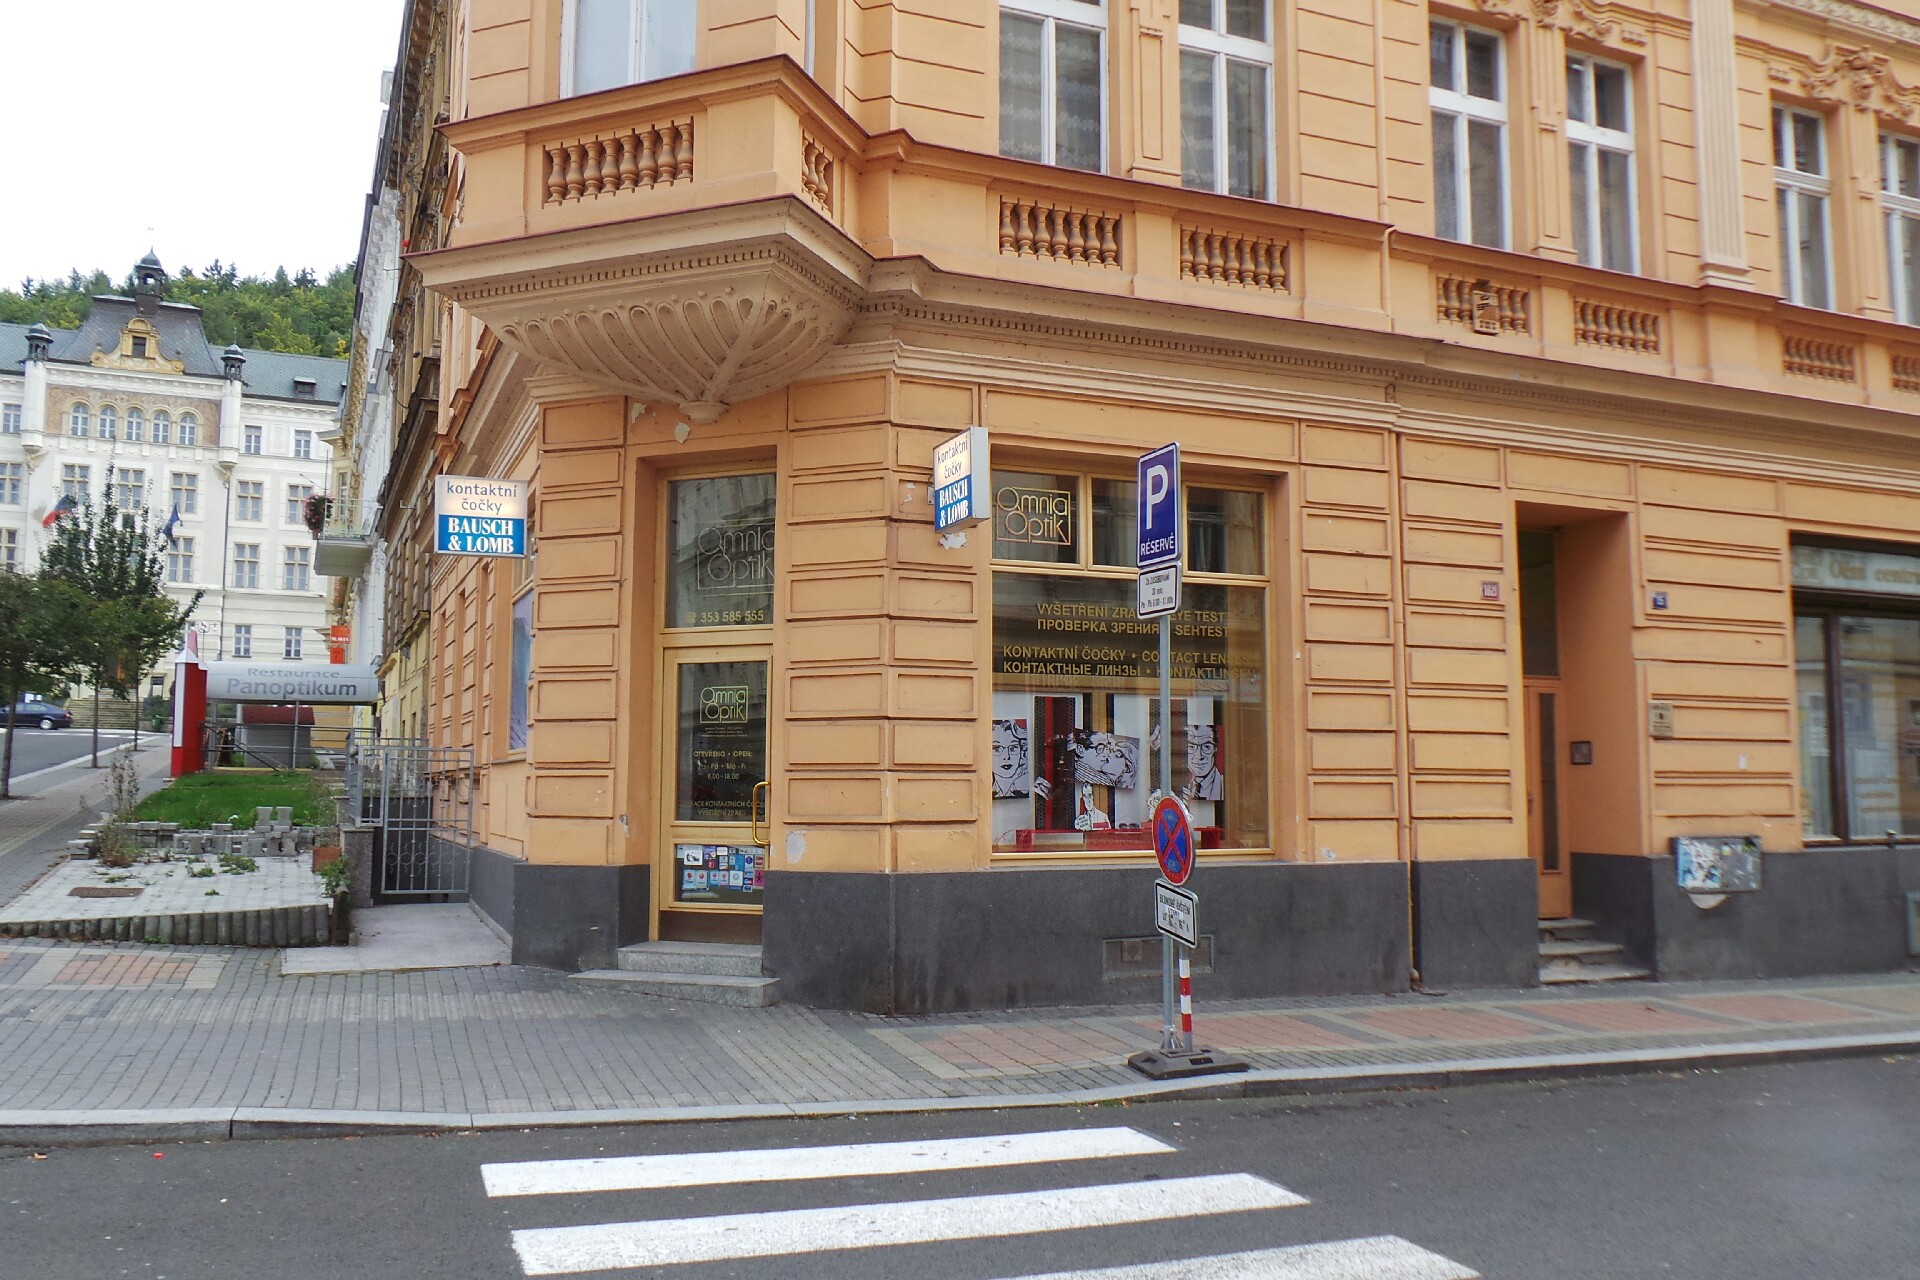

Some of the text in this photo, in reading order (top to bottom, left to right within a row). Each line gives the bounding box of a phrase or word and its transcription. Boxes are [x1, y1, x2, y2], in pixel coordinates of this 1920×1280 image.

[937, 436, 968, 465] kontaktní
[944, 460, 962, 479] čočky
[447, 481, 517, 497] kontaktní
[939, 478, 968, 508] BAUSCH
[1146, 464, 1169, 530] P
[461, 498, 502, 515] čočky
[997, 487, 1068, 516] Omnia
[940, 500, 969, 528] & LOMB
[447, 517, 514, 536] BAUSCH
[1005, 510, 1068, 543] Optik
[447, 535, 514, 553] & LOMB
[1140, 532, 1175, 556] RÉSERVÉ
[701, 610, 764, 623] 353 585 555
[1037, 601, 1108, 618] VYŠETŘENÍ
[1112, 607, 1136, 619] ZRA
[1194, 611, 1226, 623] TEST
[1037, 618, 1229, 638] ПРОВЕРКА ЗРЕНИЯ SEHTEST
[1003, 645, 1078, 660] KONTAKTNÍ
[1081, 645, 1126, 661] ČOČKY
[1141, 651, 1200, 664] COTACT
[247, 667, 340, 679] Restaurace
[1003, 661, 1092, 675] КОНТАКТНЫЕ
[1095, 664, 1140, 677] ЛИНЗЫ
[226, 678, 357, 700] Panoptikum
[701, 687, 746, 704] Omnia
[705, 702, 746, 723] Optik
[693, 750, 726, 758] OTEVŘENO
